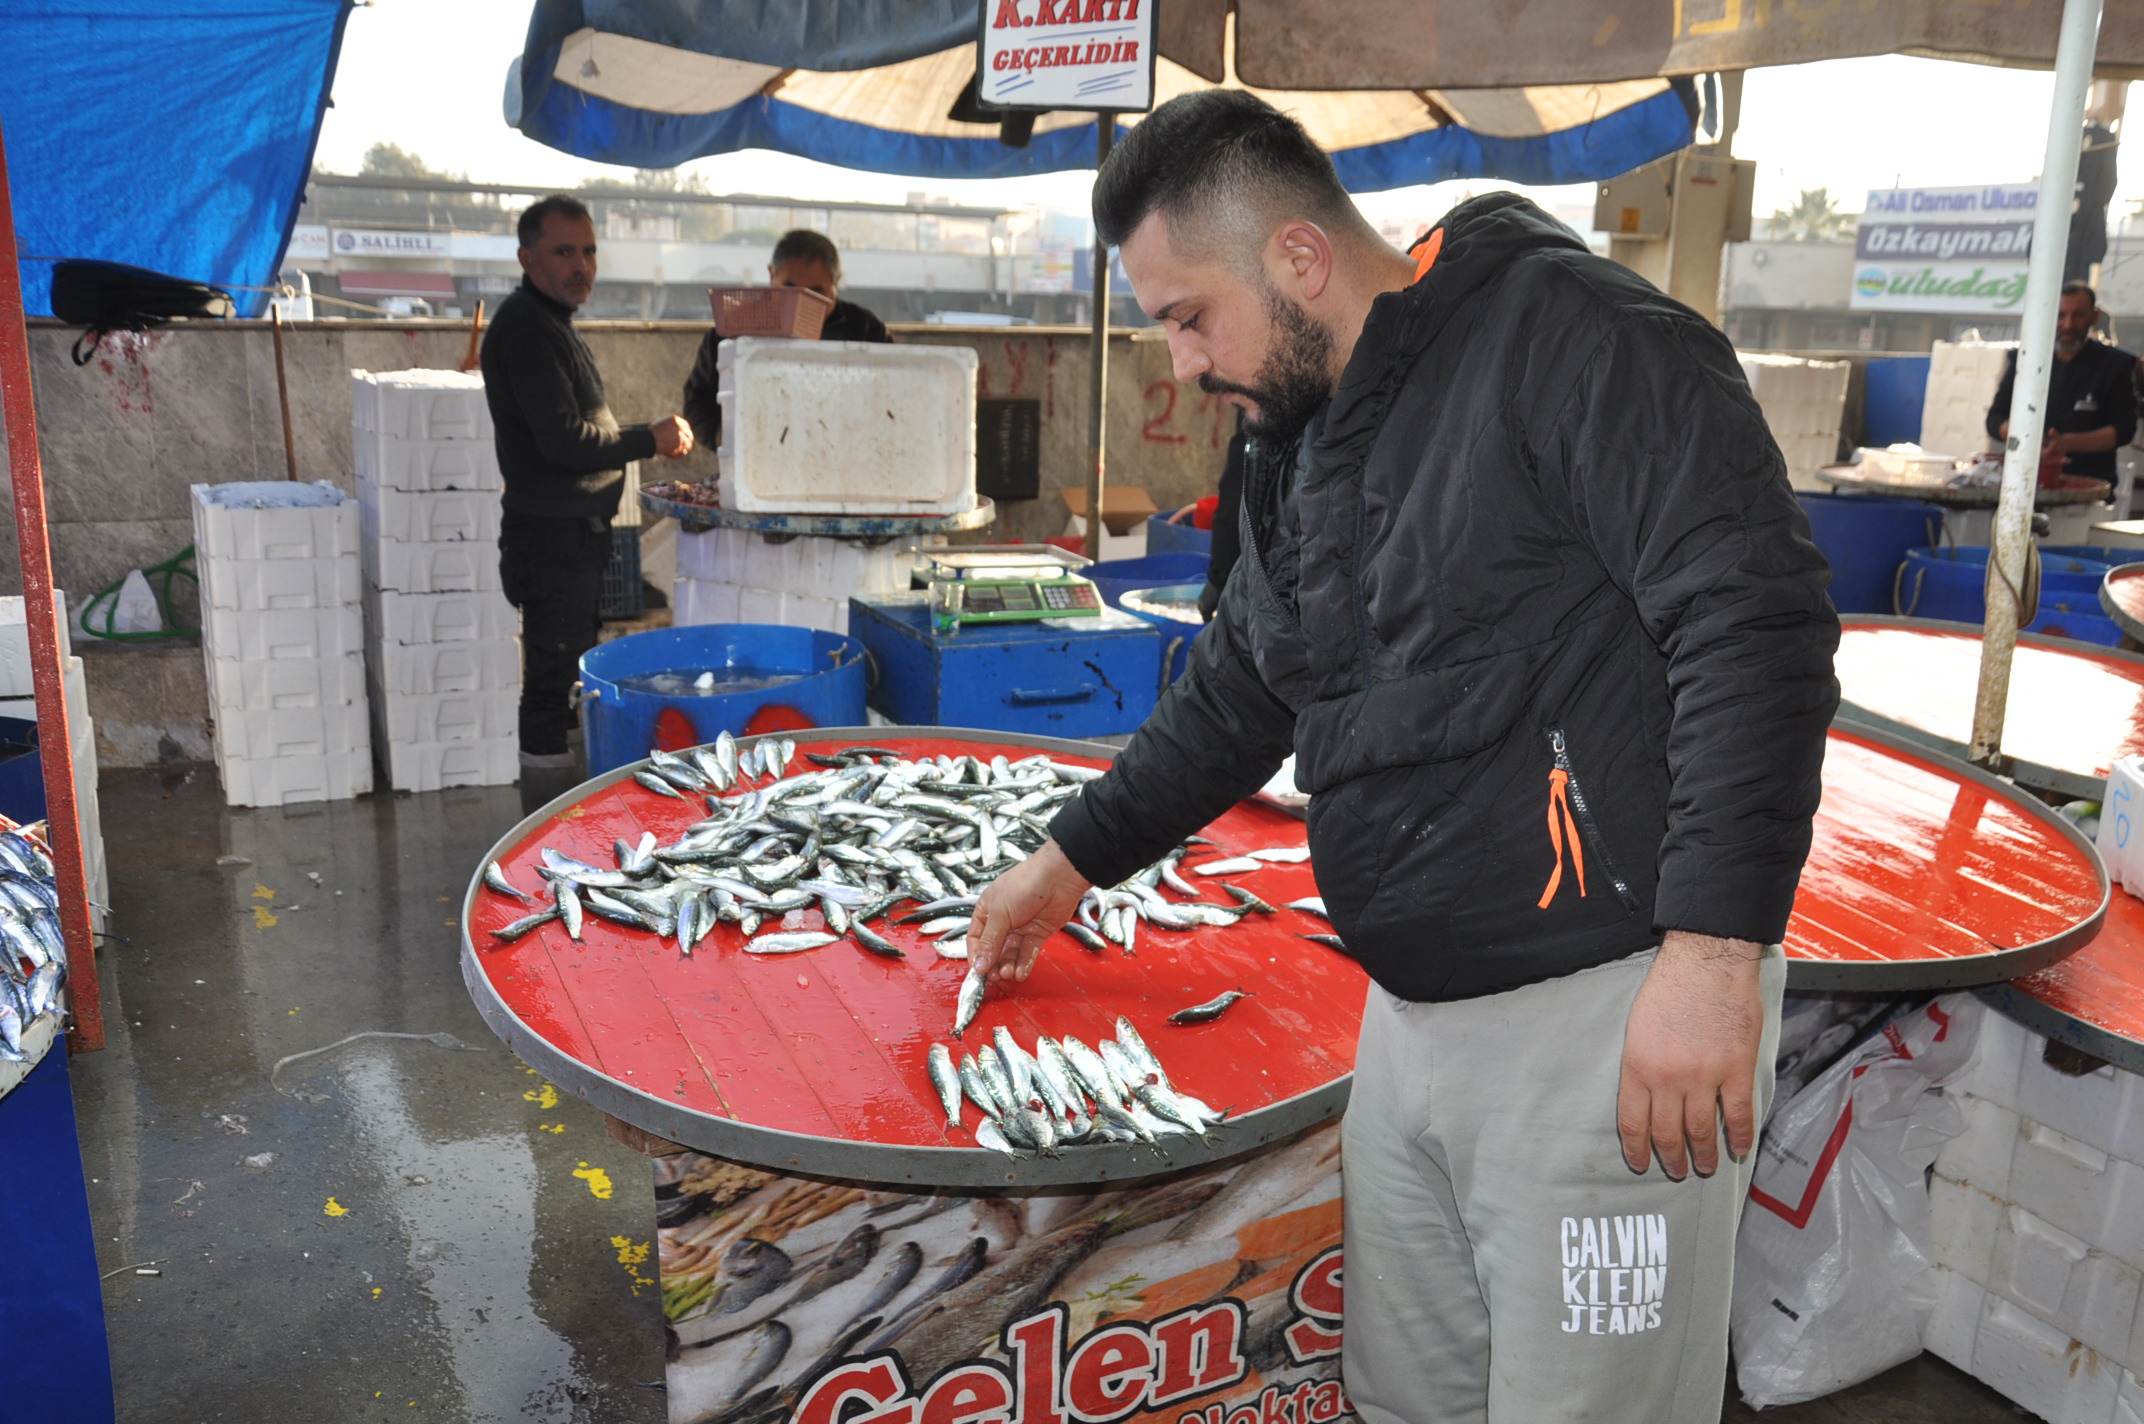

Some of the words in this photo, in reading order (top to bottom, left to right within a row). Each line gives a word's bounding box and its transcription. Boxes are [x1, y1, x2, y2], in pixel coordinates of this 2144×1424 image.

[993, 36, 1139, 75] GEÇERLİDİR
[1885, 191, 1907, 212] Ali
[1911, 190, 1977, 212] Osman
[1981, 187, 2038, 209] Uluso
[1887, 267, 2029, 309] uludağ
[1561, 1214, 1667, 1268] CALVIN
[1563, 1266, 1667, 1305] KLEIN
[1561, 1301, 1663, 1335] JEANS
[799, 1306, 1243, 1424] Gelen
